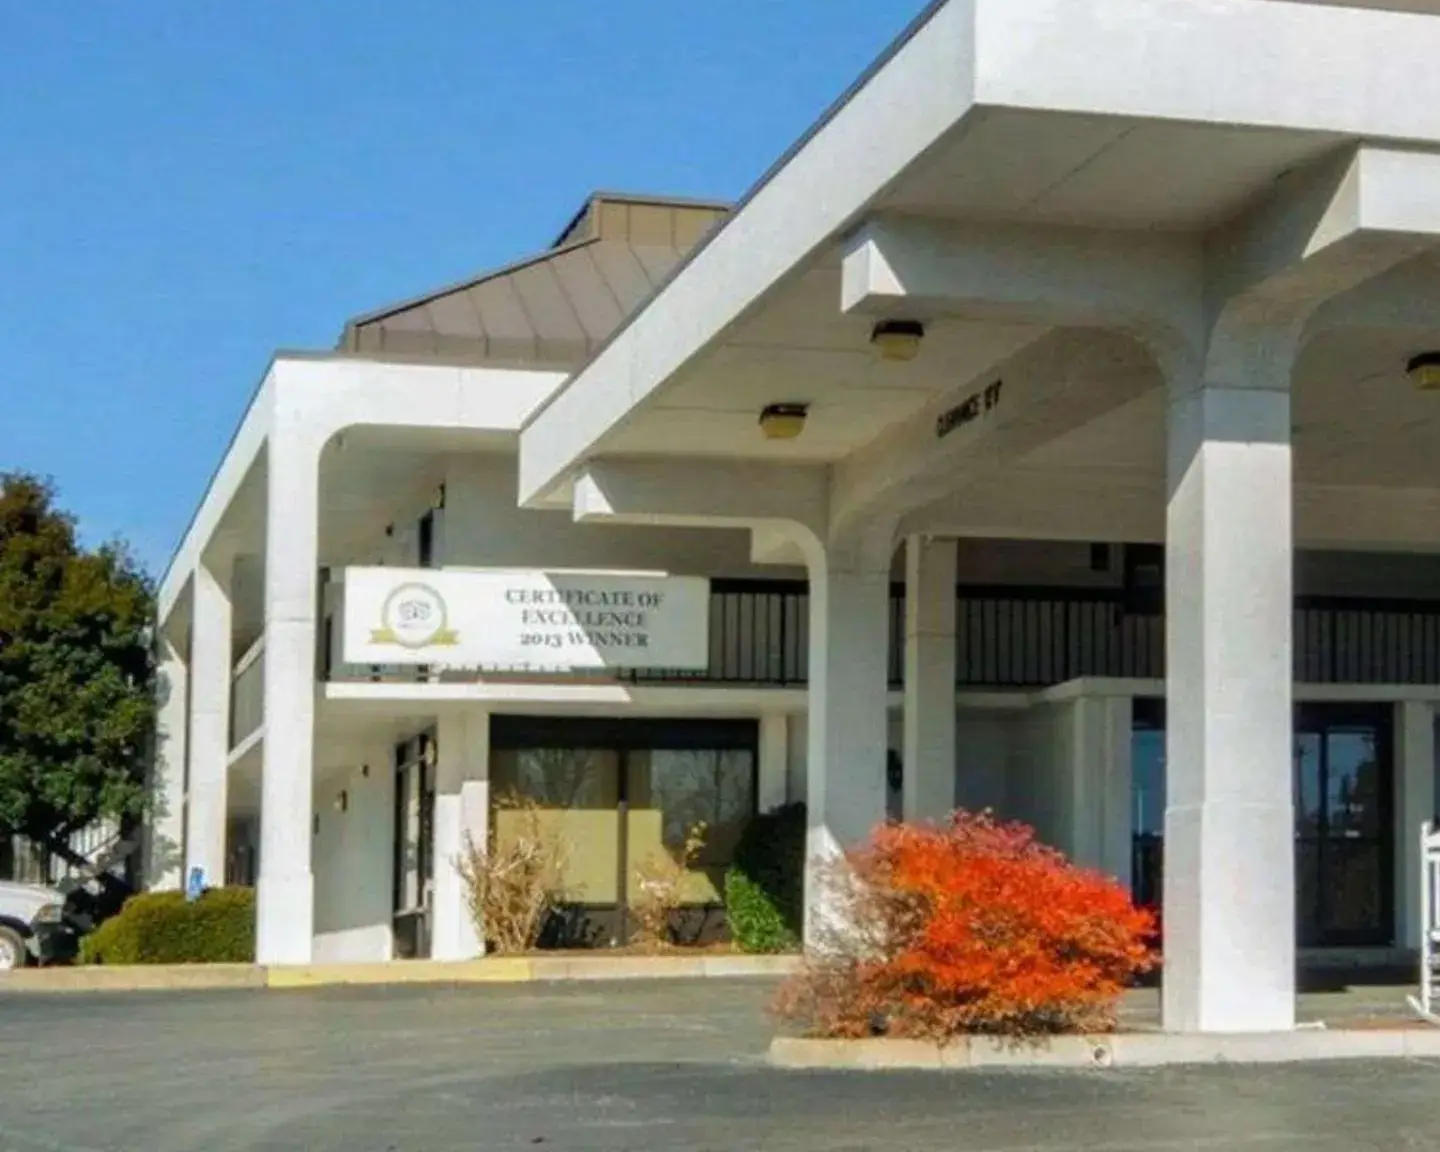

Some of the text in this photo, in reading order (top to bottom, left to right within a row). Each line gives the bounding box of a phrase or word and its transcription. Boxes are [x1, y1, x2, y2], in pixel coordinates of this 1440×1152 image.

[505, 589, 664, 607] CERTIFICATE OF
[521, 608, 644, 626] EXCELLENCE
[520, 631, 649, 648] 2013 WINNER
